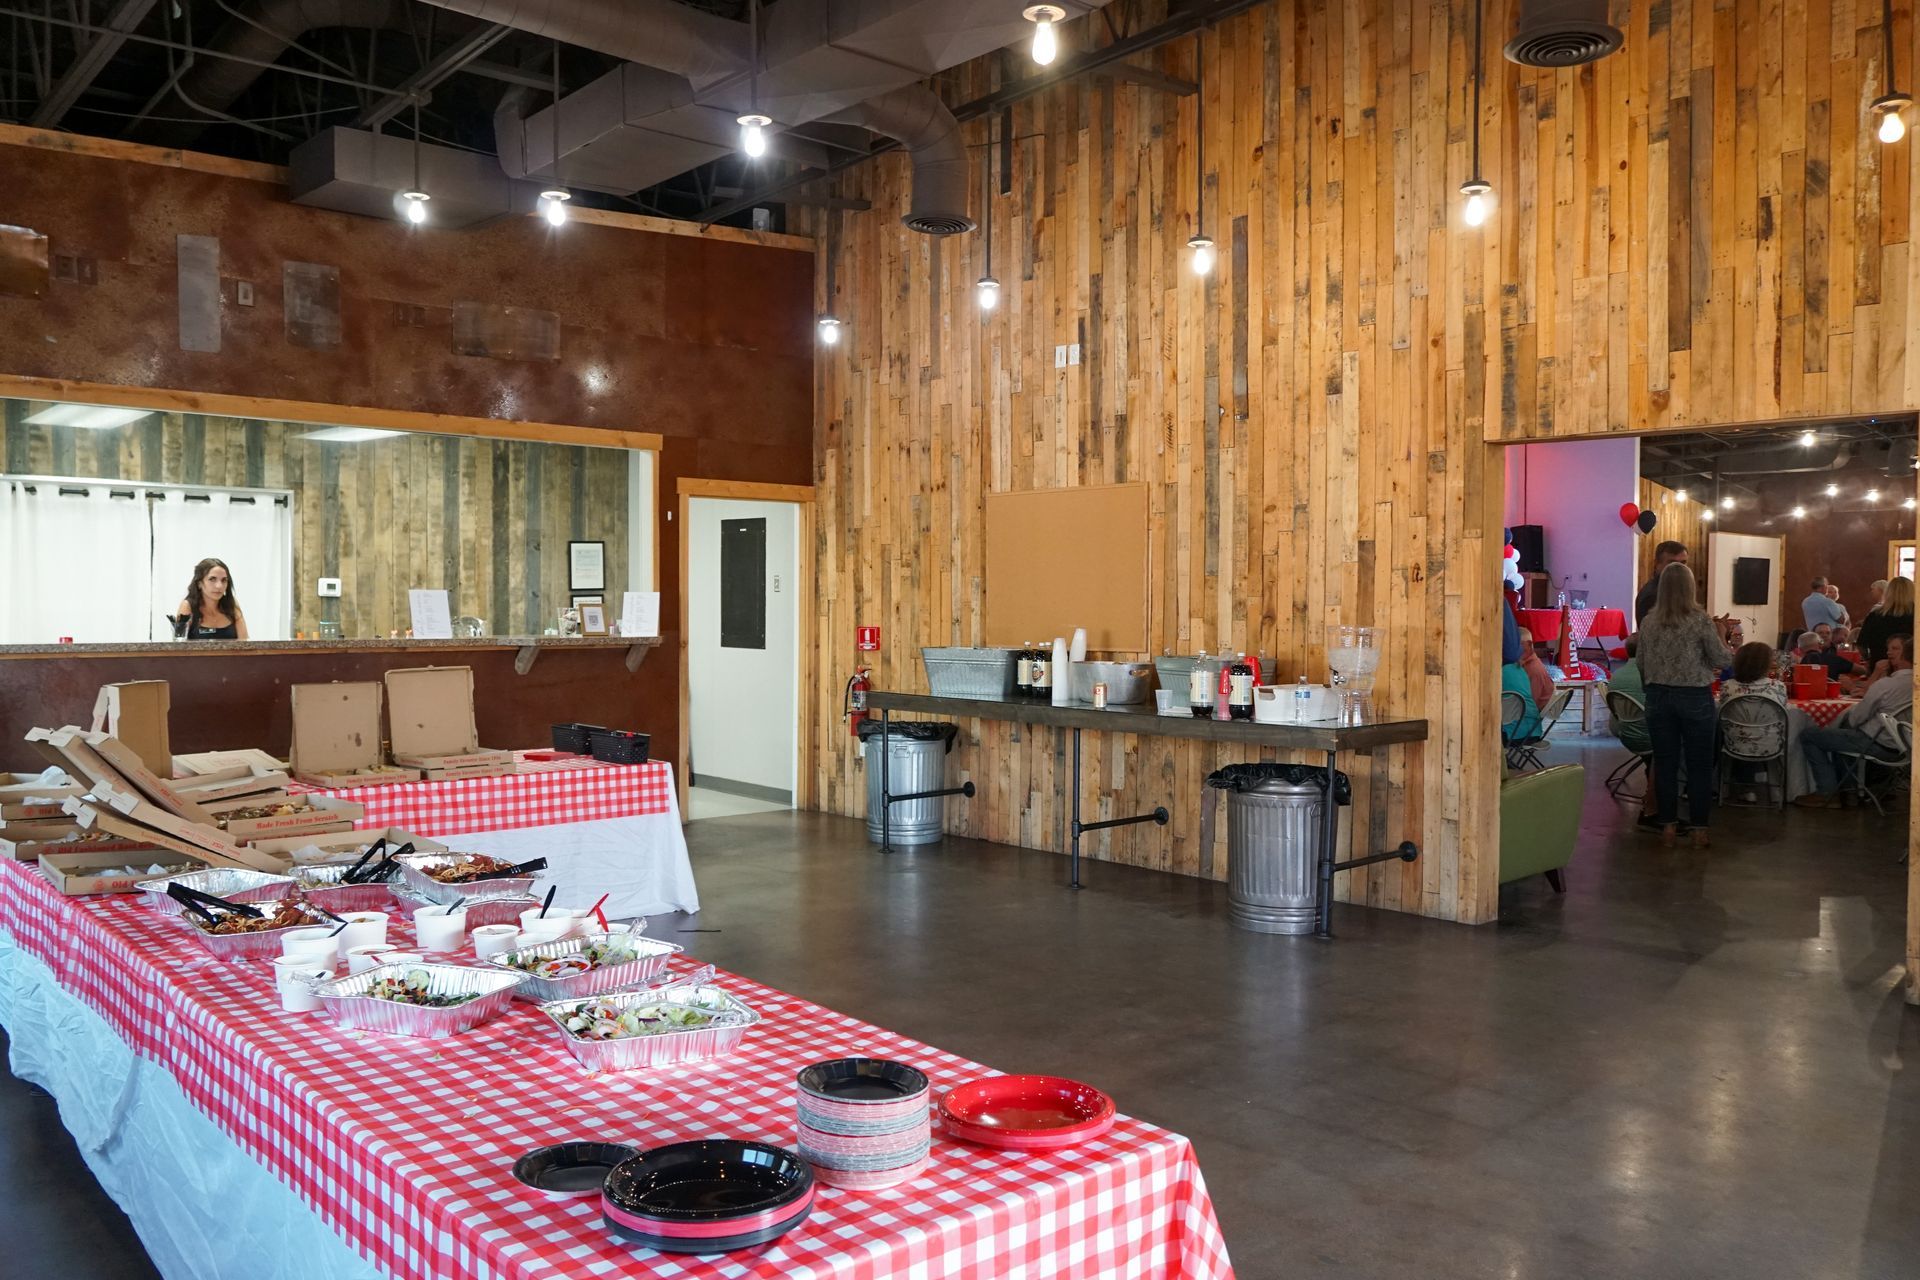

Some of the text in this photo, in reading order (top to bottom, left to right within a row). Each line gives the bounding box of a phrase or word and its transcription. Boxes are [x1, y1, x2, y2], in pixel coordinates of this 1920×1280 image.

[275, 819, 294, 827] Fresh
[295, 817, 313, 825] From
[313, 814, 339, 822] Scratch
[111, 880, 129, 888] Old
